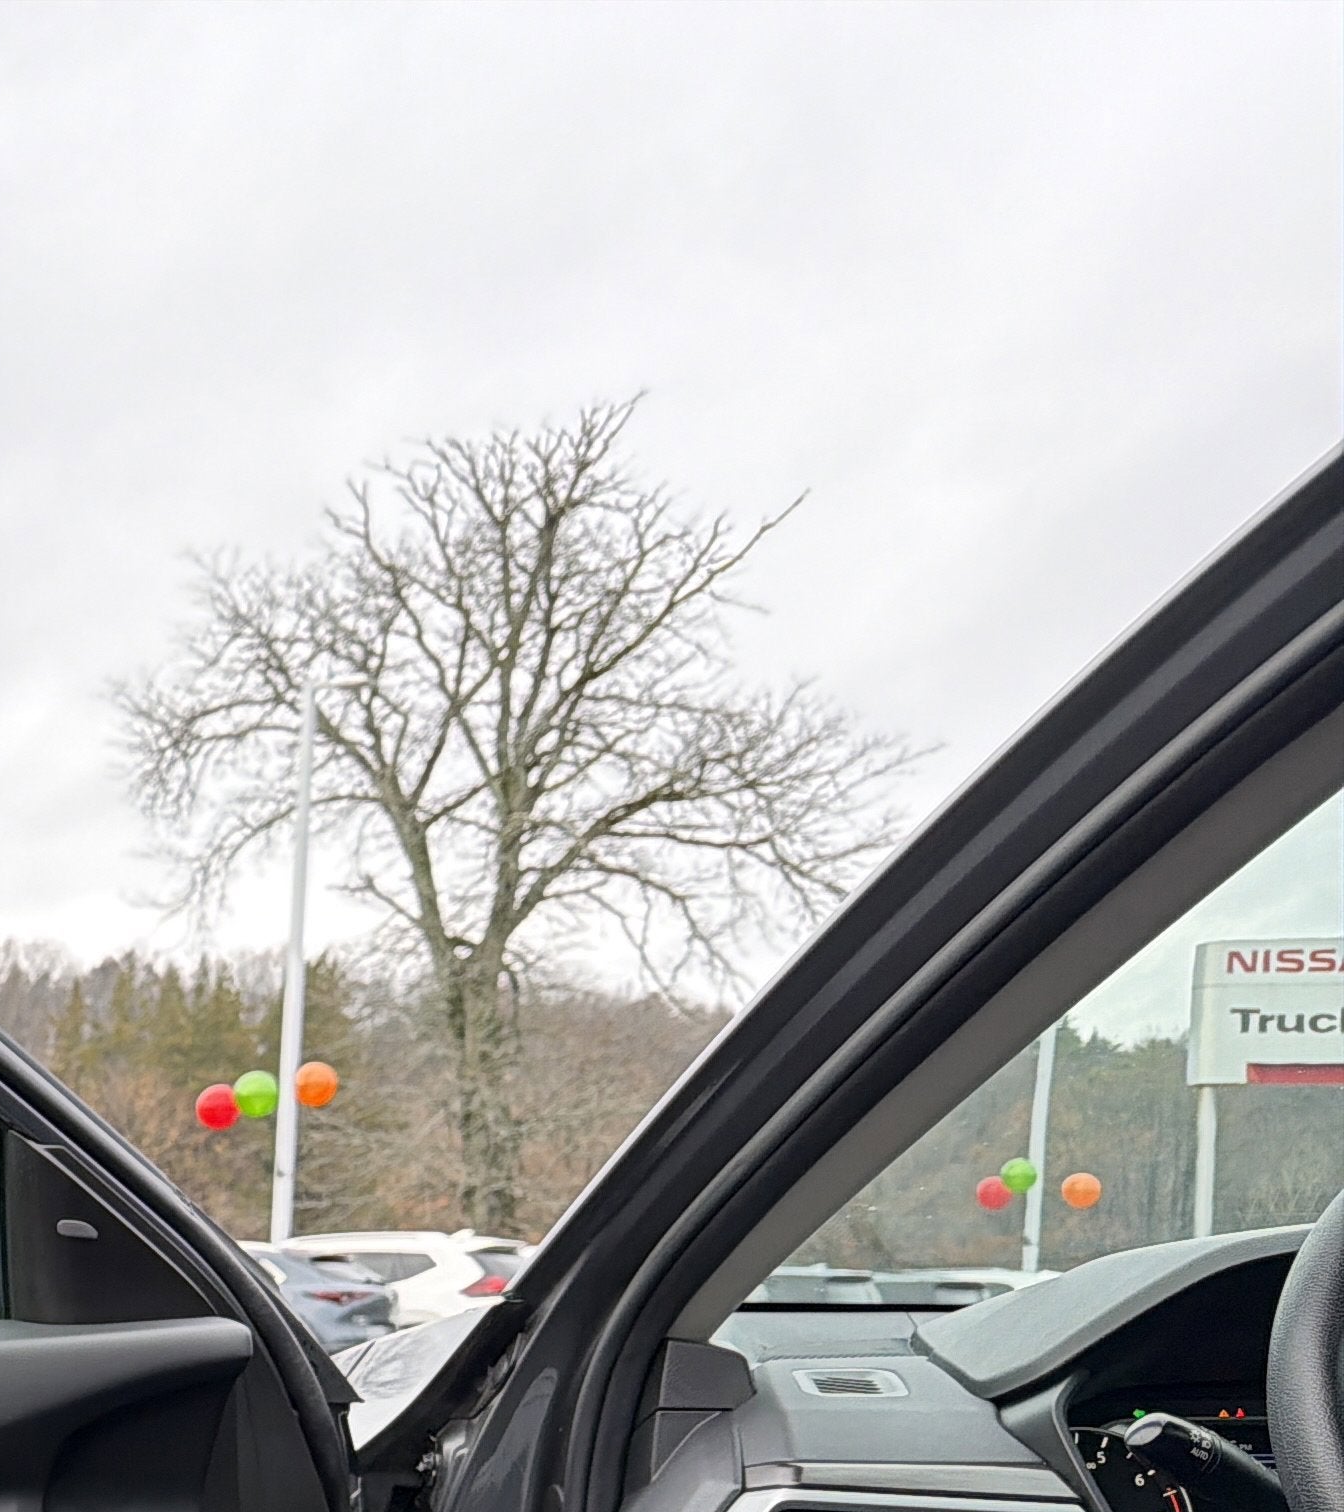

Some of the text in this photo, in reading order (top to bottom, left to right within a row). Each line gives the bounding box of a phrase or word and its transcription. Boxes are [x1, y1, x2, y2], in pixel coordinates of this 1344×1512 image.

[1226, 948, 1344, 974] NISS
[1230, 1007, 1344, 1034] Truc
[1097, 1450, 1106, 1464] 5
[1190, 1446, 1209, 1461] AUTO
[1134, 1473, 1145, 1486] 6
